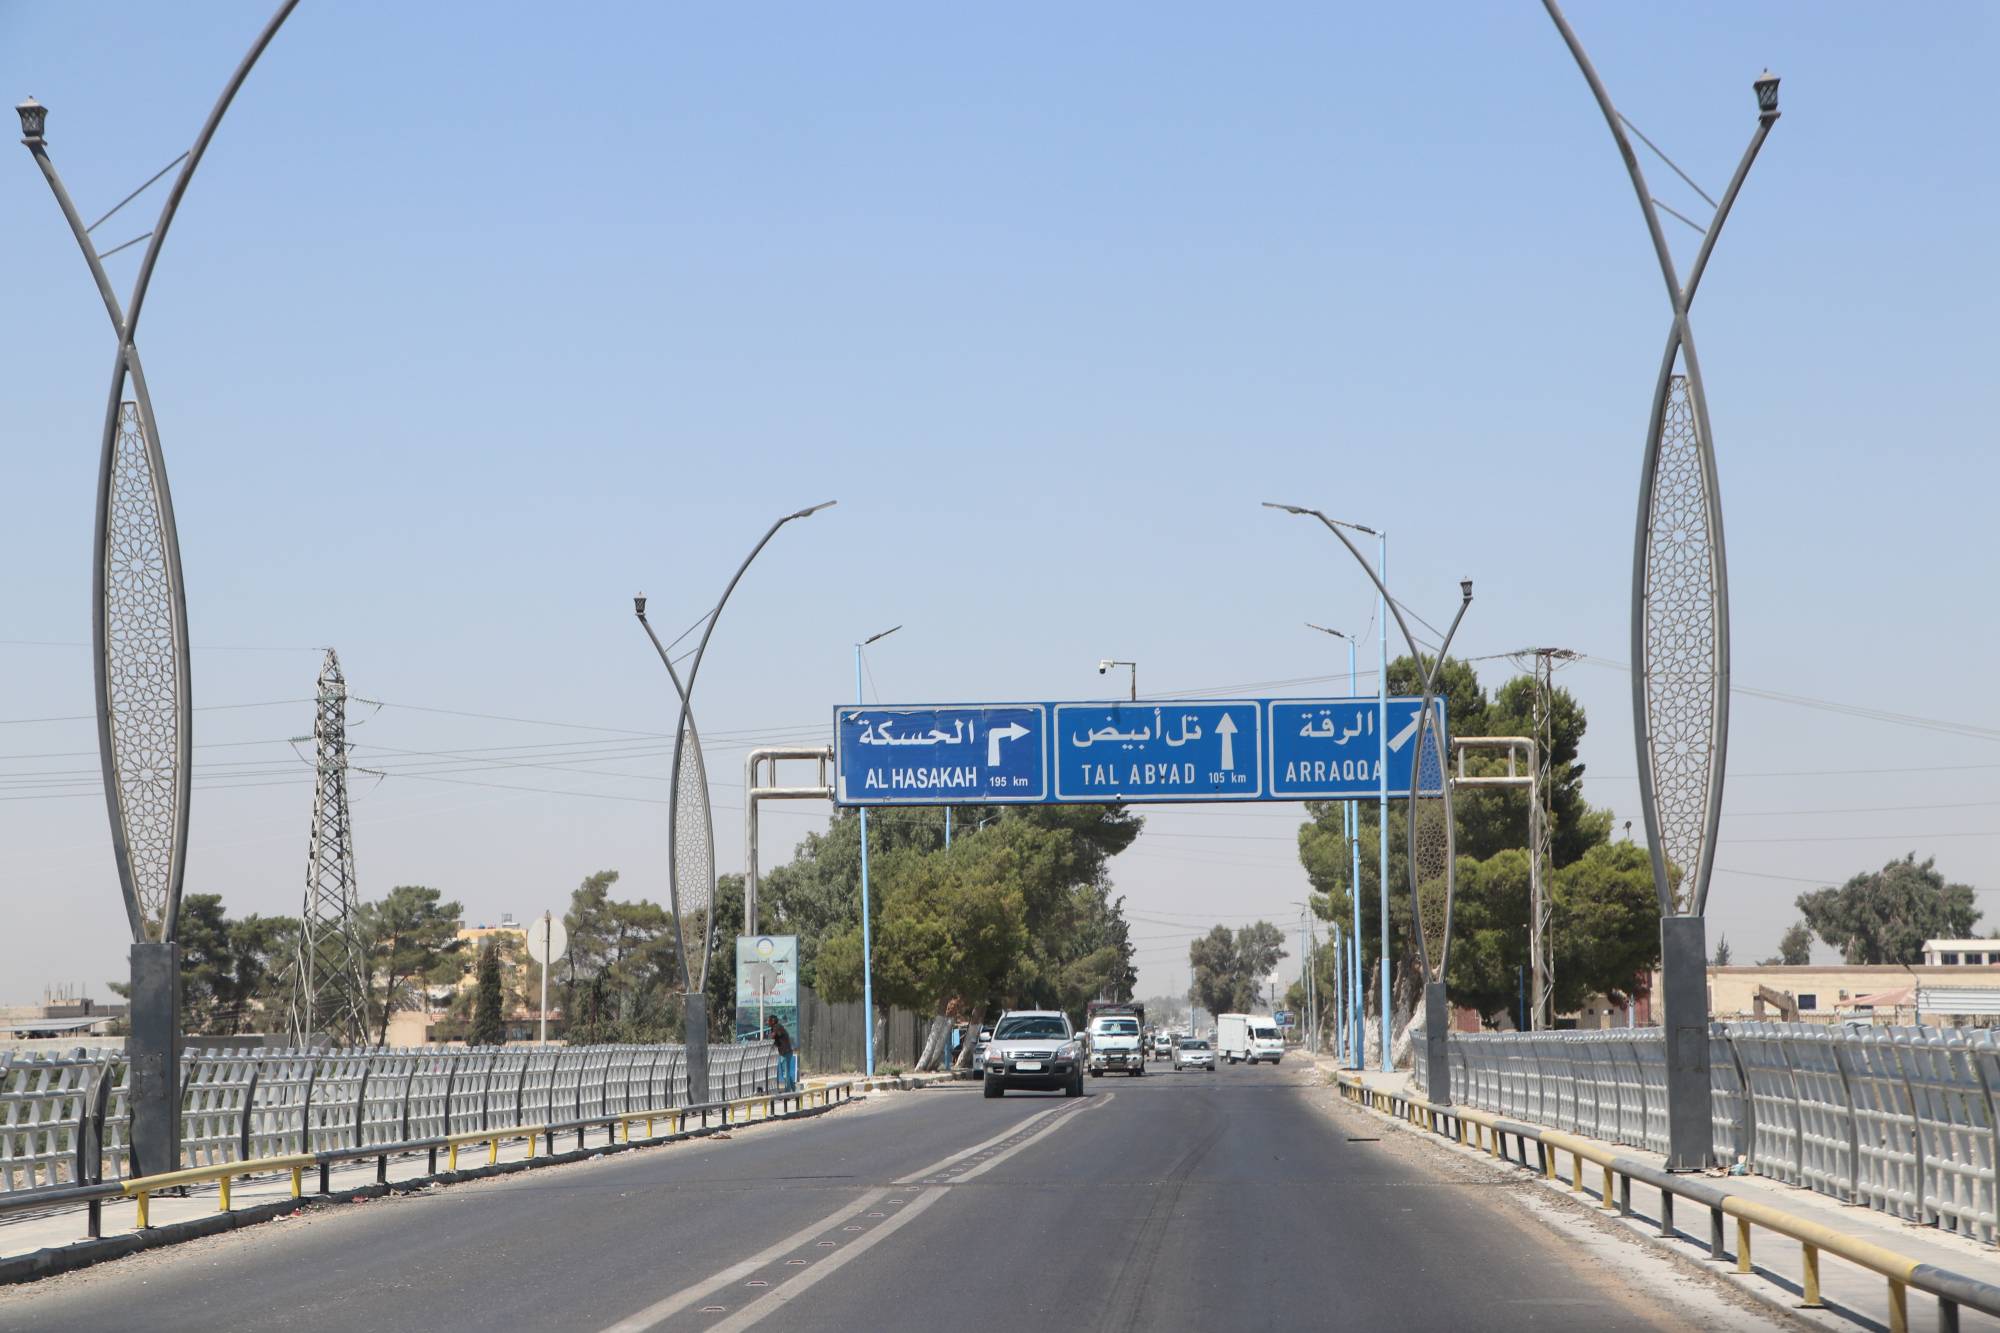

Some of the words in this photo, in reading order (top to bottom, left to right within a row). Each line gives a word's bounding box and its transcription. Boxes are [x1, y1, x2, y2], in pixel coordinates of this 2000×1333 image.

[858, 719, 975, 746] الحسكة
[1072, 708, 1162, 750] أبيض
[1165, 714, 1202, 747] تل
[1299, 709, 1373, 745] الرقة
[865, 768, 889, 789] AL
[892, 767, 977, 789] HASAKAH
[990, 777, 1007, 787] 195
[1013, 776, 1028, 787] km
[1081, 764, 1119, 785] TAL
[1129, 763, 1195, 785] ABYAD
[1208, 772, 1225, 784] 105
[1231, 772, 1247, 784] km
[1285, 760, 1381, 783] ARRAQQA
